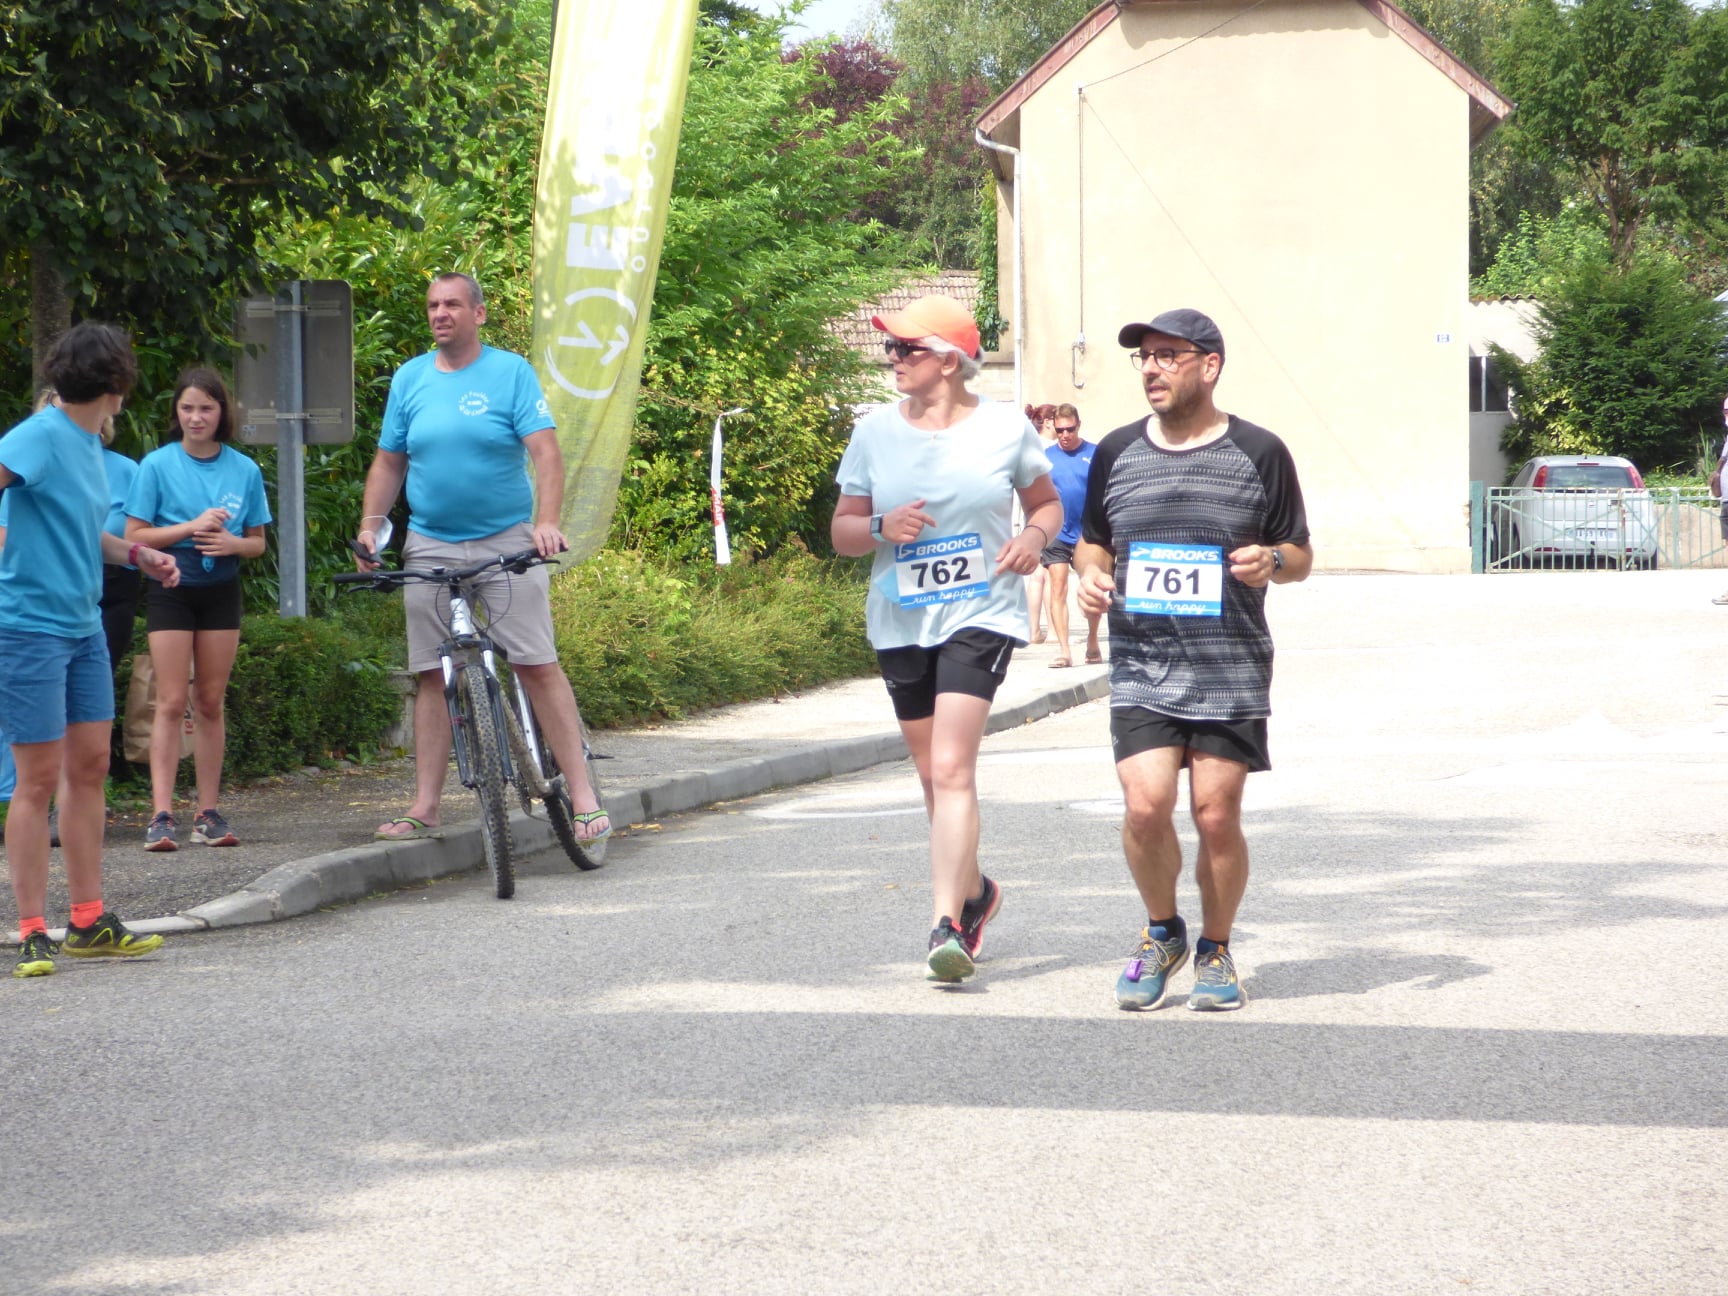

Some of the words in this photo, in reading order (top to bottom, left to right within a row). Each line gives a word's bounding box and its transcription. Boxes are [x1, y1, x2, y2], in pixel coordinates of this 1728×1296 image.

[916, 536, 978, 556] BROOKS
[1150, 548, 1219, 561] BROOKS
[910, 556, 971, 588] 762
[1144, 566, 1200, 595] 761
